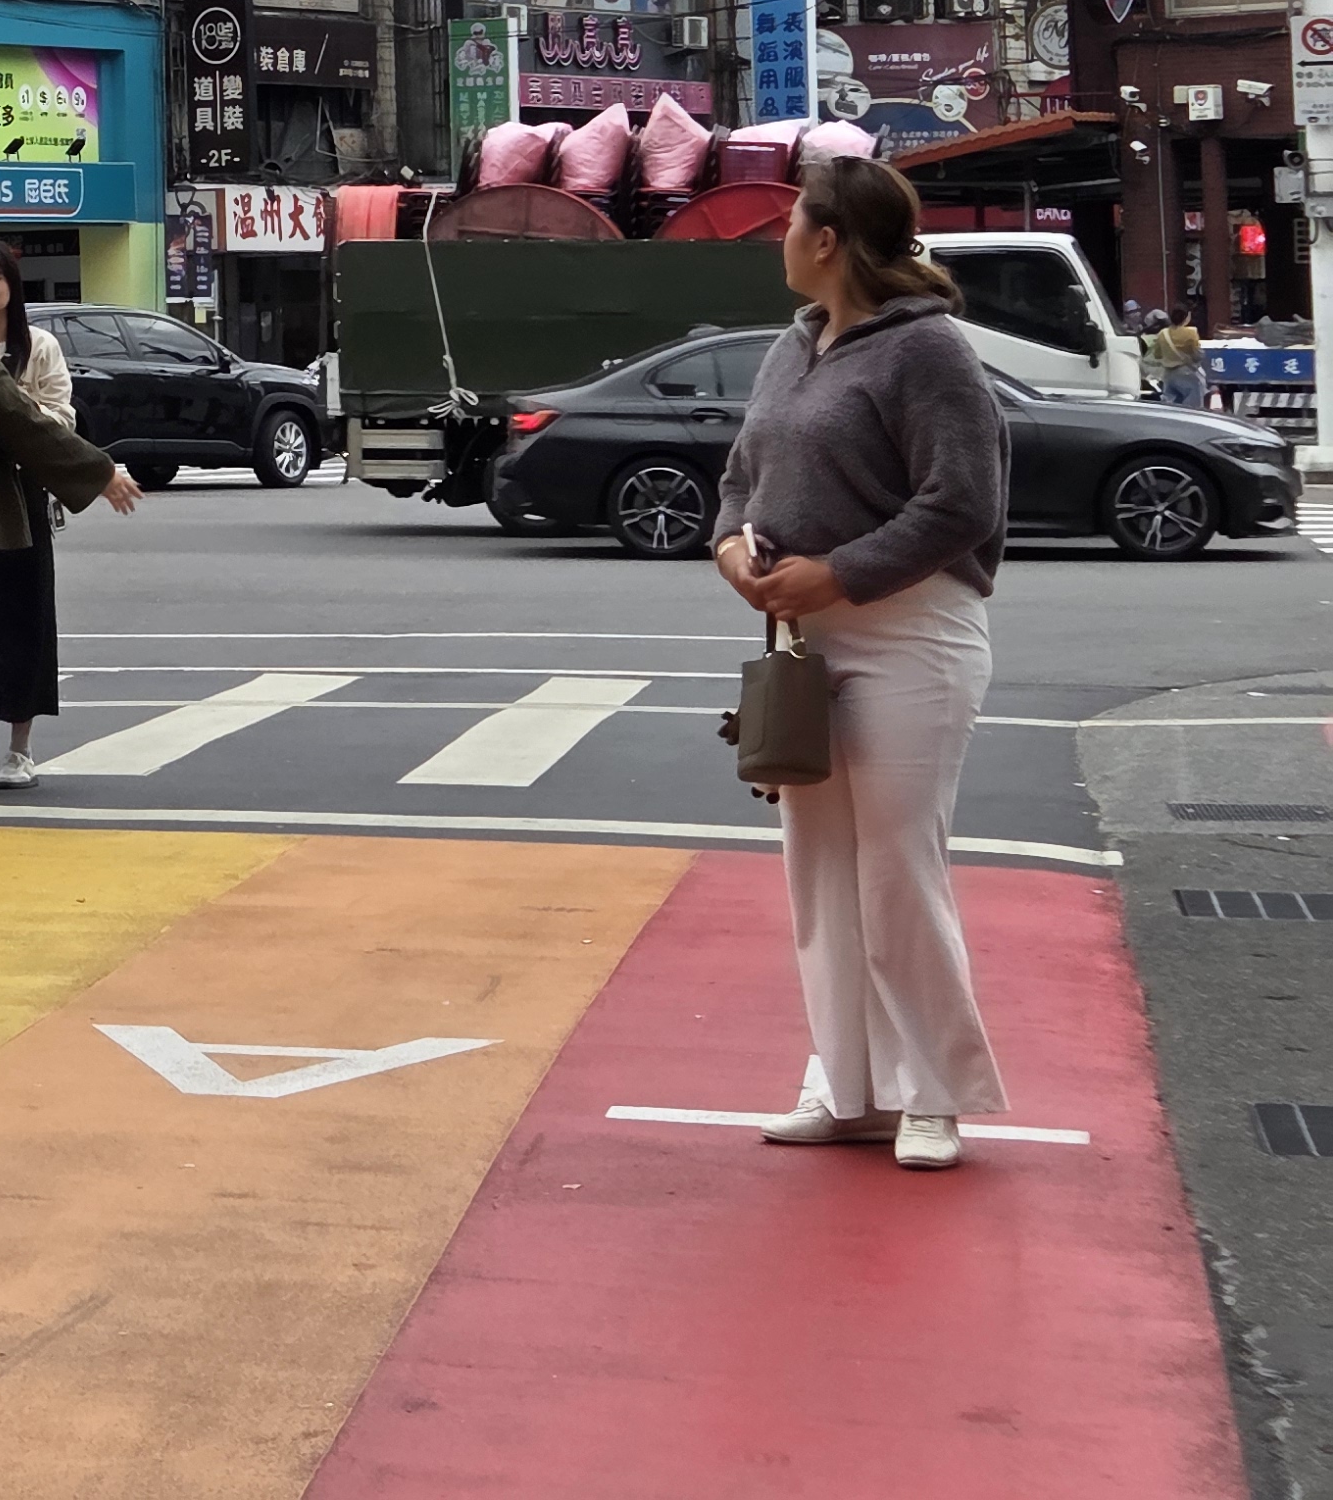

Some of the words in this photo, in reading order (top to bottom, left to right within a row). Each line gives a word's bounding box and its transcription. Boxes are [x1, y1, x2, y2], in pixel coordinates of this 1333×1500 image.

[254, 45, 307, 73] 裝倉庫
[754, 11, 779, 118] 舞蹈用品
[782, 10, 807, 118] 表演服裝
[194, 75, 215, 132] 道具
[222, 74, 245, 131] 變裝
[24, 178, 70, 204] 屈臣氏
